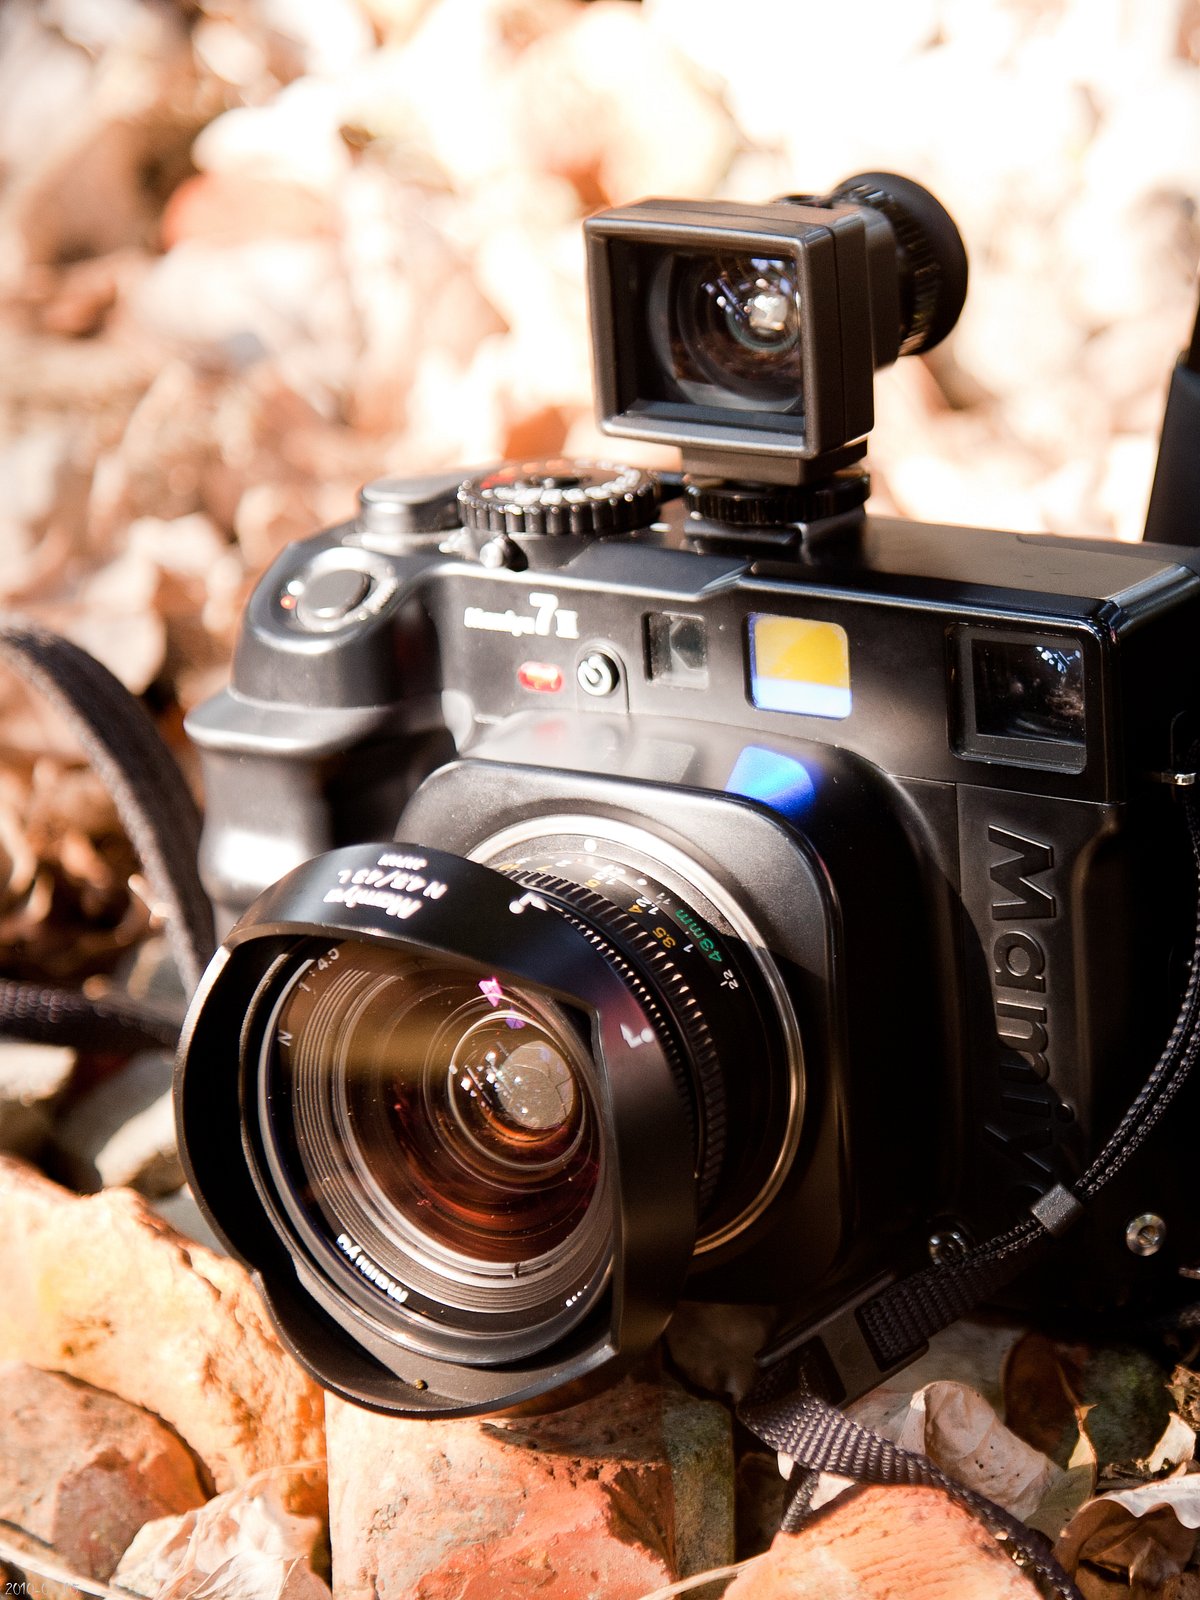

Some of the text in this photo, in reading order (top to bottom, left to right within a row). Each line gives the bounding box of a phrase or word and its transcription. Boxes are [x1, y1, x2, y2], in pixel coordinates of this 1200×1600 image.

[628, 903, 643, 915] 4
[635, 895, 659, 916] 1.2
[652, 926, 676, 950] 3.5
[674, 908, 723, 963] 43mm
[722, 968, 739, 991] 22
[277, 1020, 294, 1048] N
